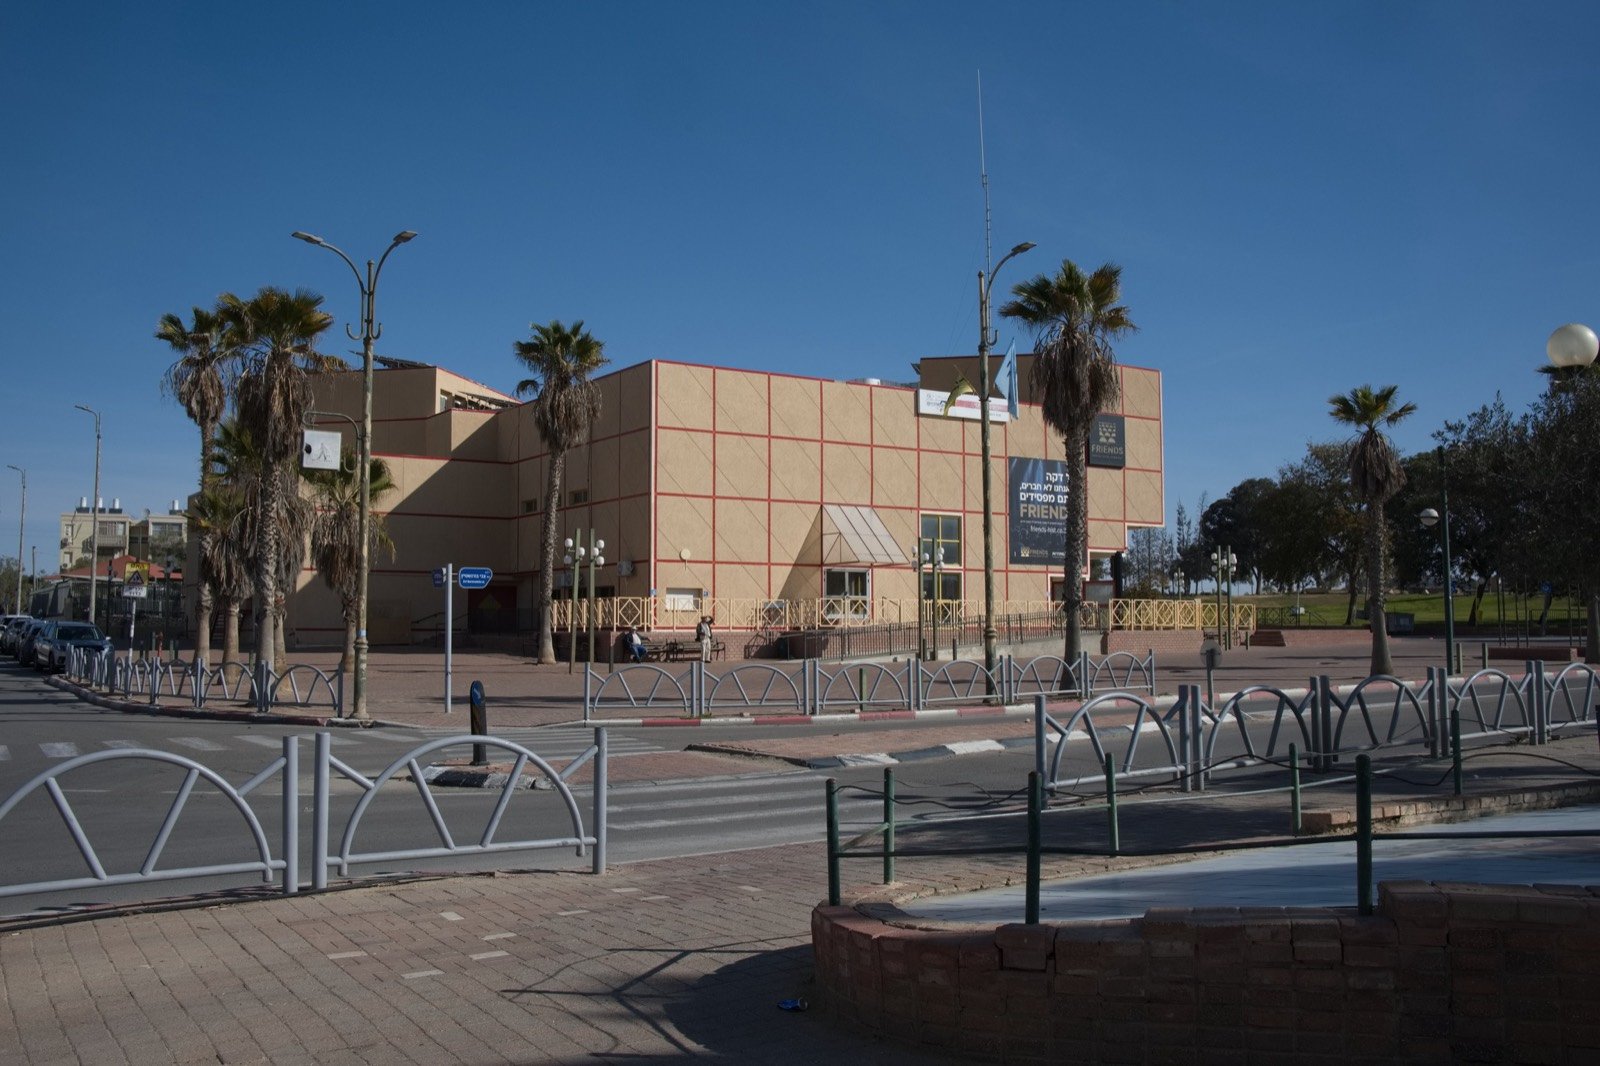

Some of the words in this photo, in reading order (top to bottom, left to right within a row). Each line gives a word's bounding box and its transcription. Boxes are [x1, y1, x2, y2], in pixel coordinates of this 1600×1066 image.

[1091, 444, 1123, 455] FRIENDS
[1046, 472, 1064, 483] דקה
[1020, 482, 1042, 491] חברים,
[1043, 483, 1052, 491] לא
[1020, 492, 1055, 503] מפסידים
[1057, 495, 1068, 503] תם
[1020, 503, 1068, 520] FRIEND
